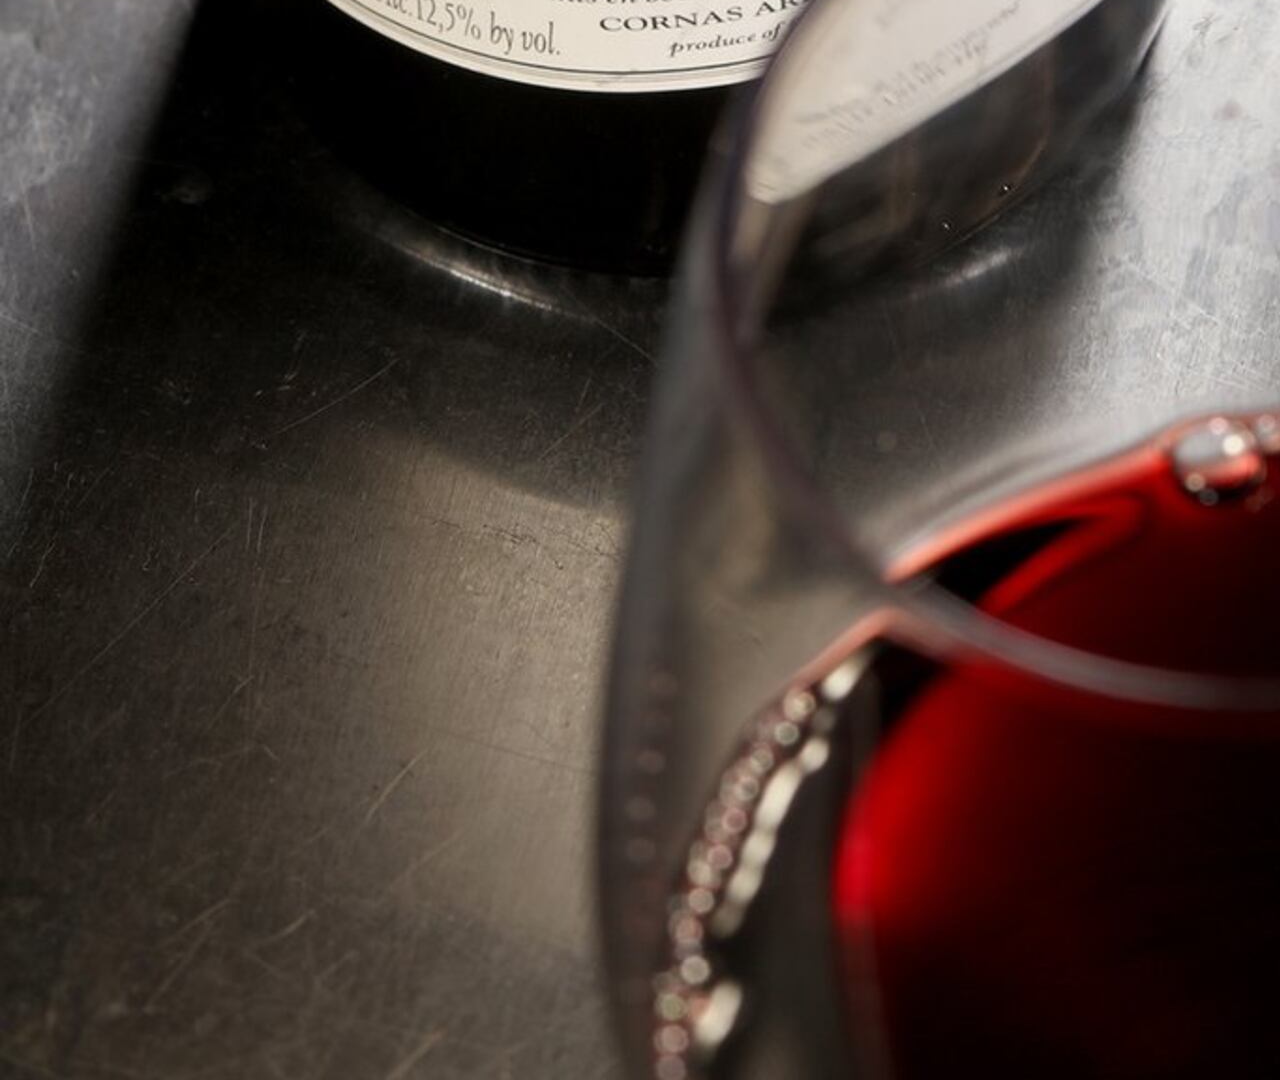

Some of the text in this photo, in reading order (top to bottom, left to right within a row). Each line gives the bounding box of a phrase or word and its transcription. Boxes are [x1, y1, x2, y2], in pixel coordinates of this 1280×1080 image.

[490, 11, 515, 55] by
[522, 21, 561, 56] vol.
[599, 5, 743, 32] CORNAS
[668, 19, 786, 58] produce of
